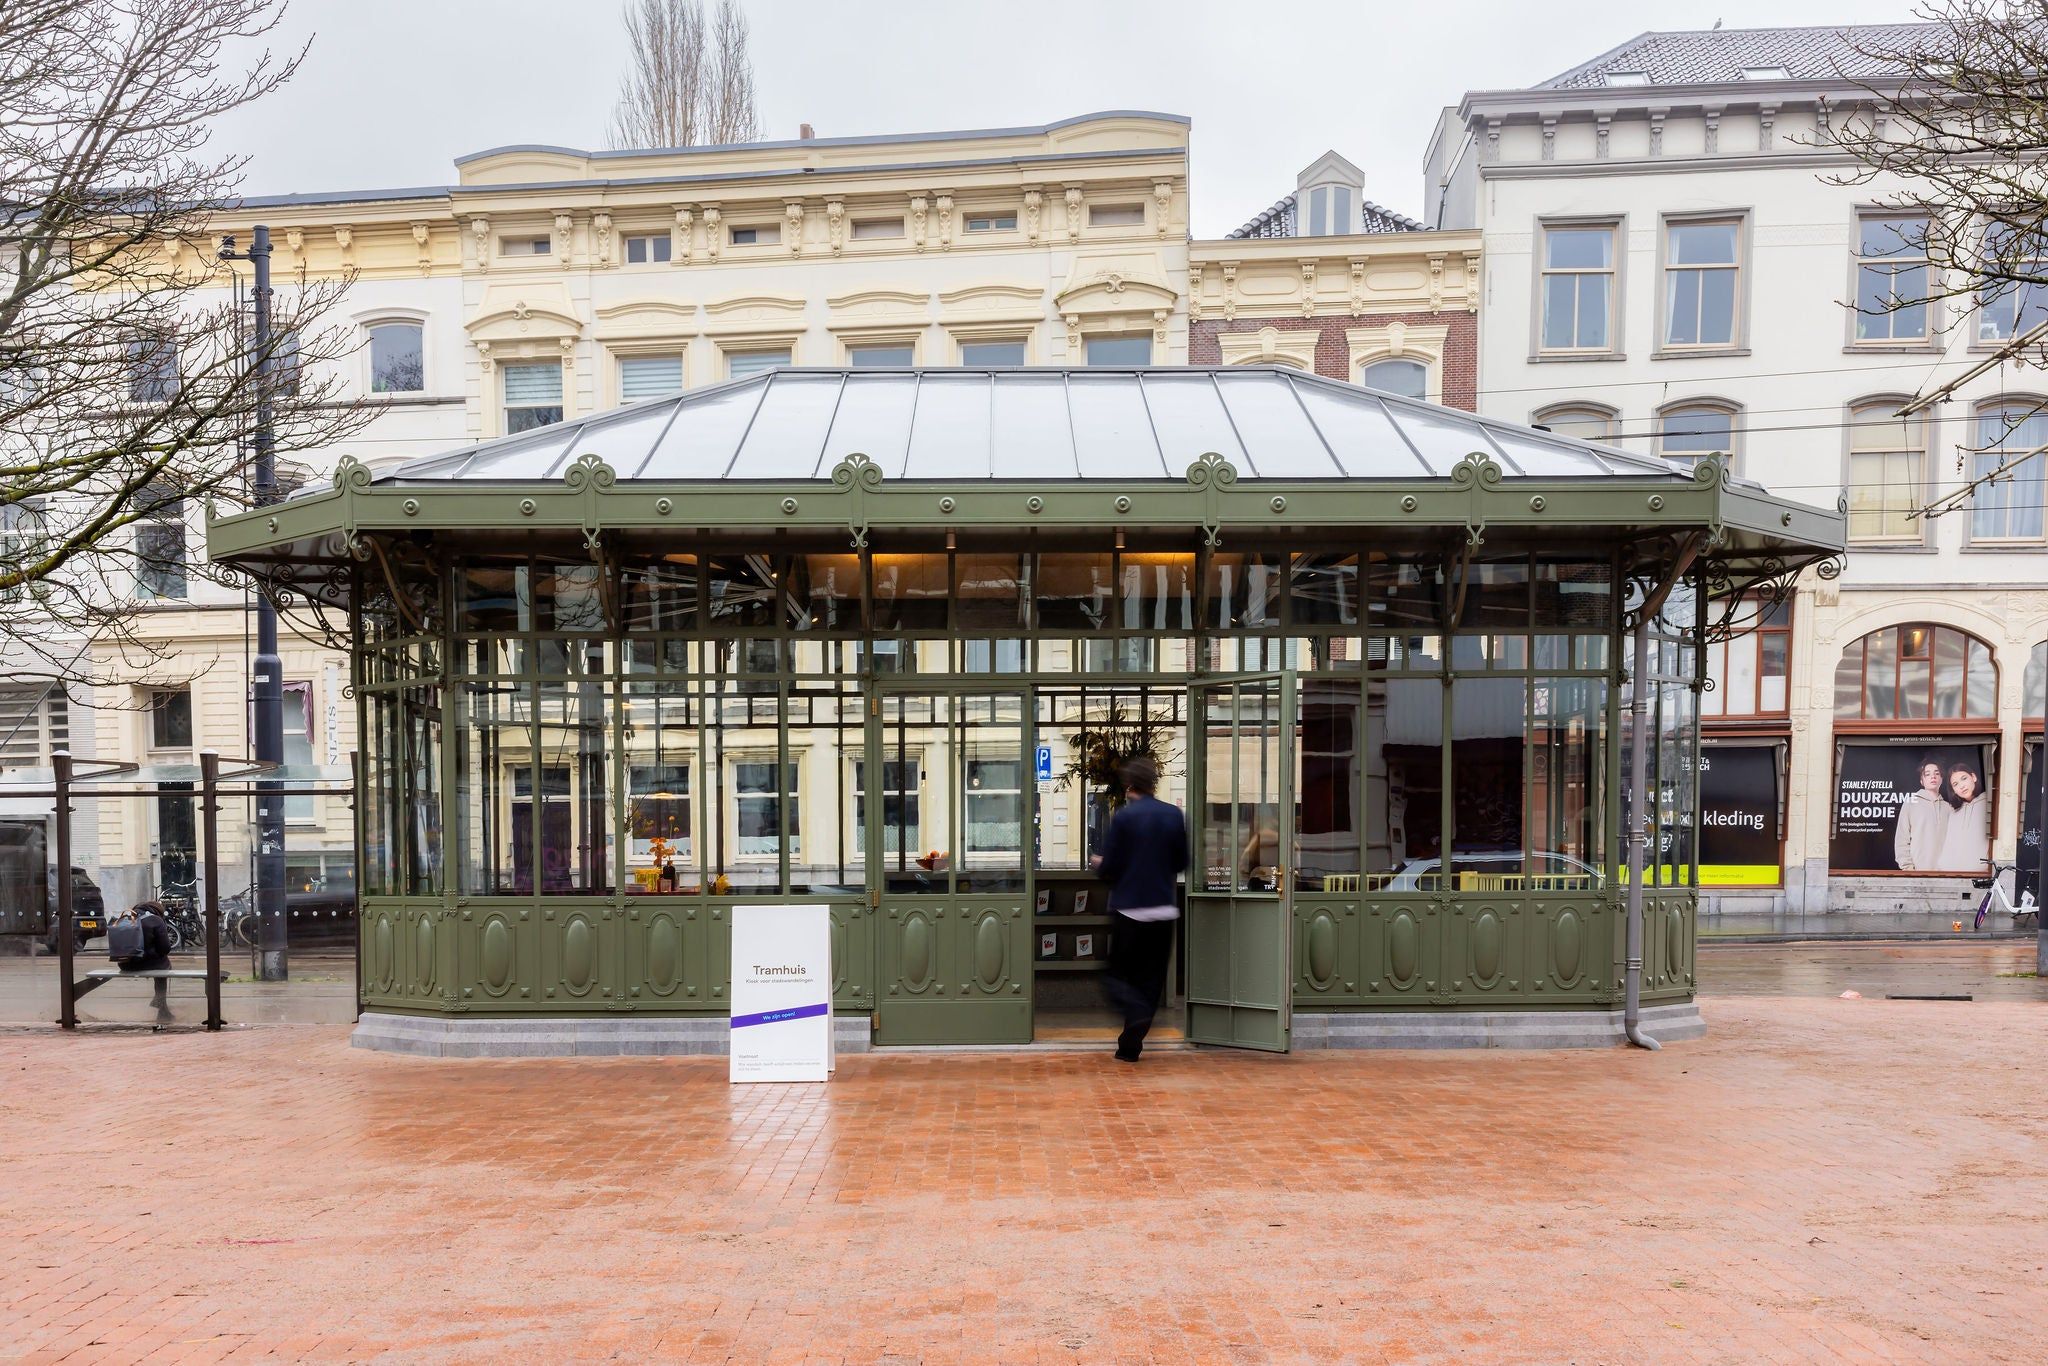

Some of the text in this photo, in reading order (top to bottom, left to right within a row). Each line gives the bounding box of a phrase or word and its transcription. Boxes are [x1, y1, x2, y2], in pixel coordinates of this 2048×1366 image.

[1841, 780, 1893, 789] STANLEY/STELLA
[1841, 792, 1919, 803] DUURZAME
[1840, 807, 1896, 818] HOODIE
[1703, 810, 1764, 830] kleding
[753, 965, 806, 975] Tramhuis
